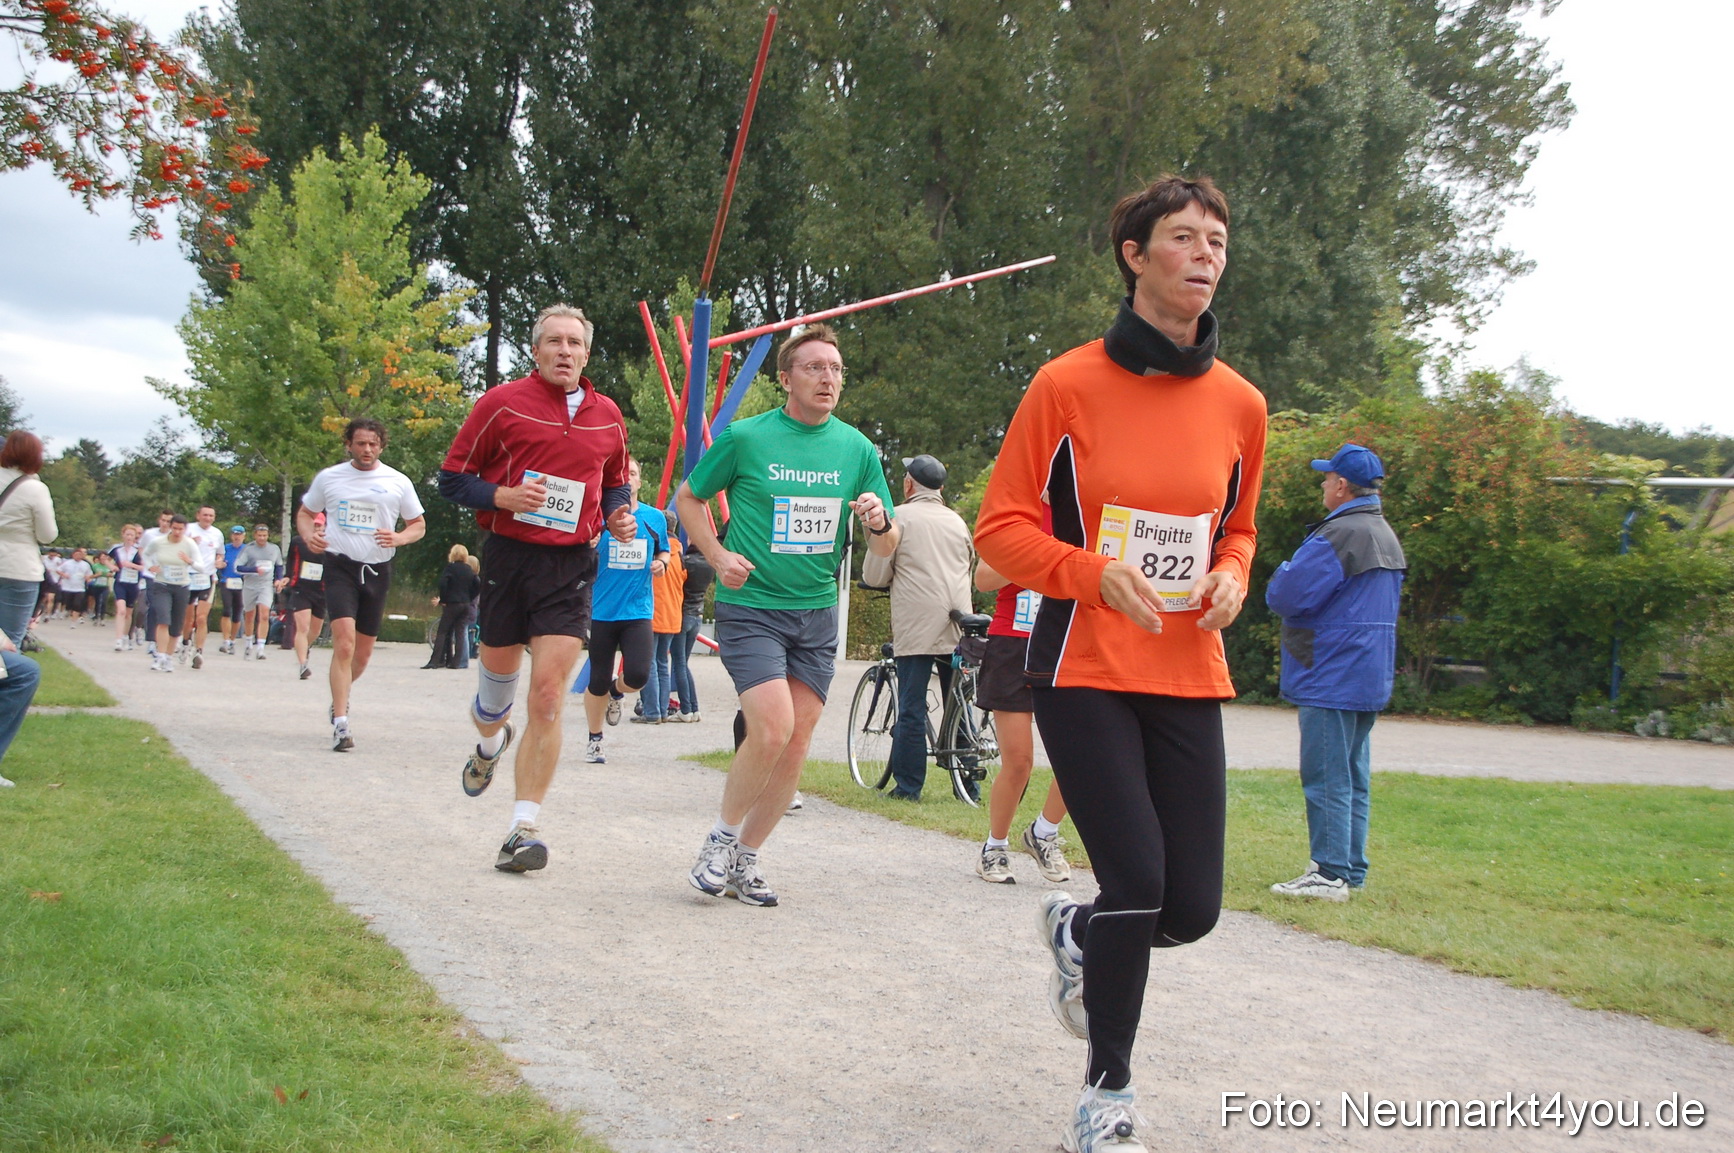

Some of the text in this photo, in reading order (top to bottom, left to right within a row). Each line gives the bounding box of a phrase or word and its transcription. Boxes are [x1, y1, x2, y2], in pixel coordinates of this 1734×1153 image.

[768, 464, 840, 487] Sinupret
[541, 496, 574, 514] 962
[793, 502, 826, 513] Andreas
[350, 513, 372, 523] 2131
[793, 519, 832, 534] 3317
[1134, 519, 1192, 546] Brigitte
[619, 551, 642, 559] 2298
[1141, 552, 1195, 581] 822
